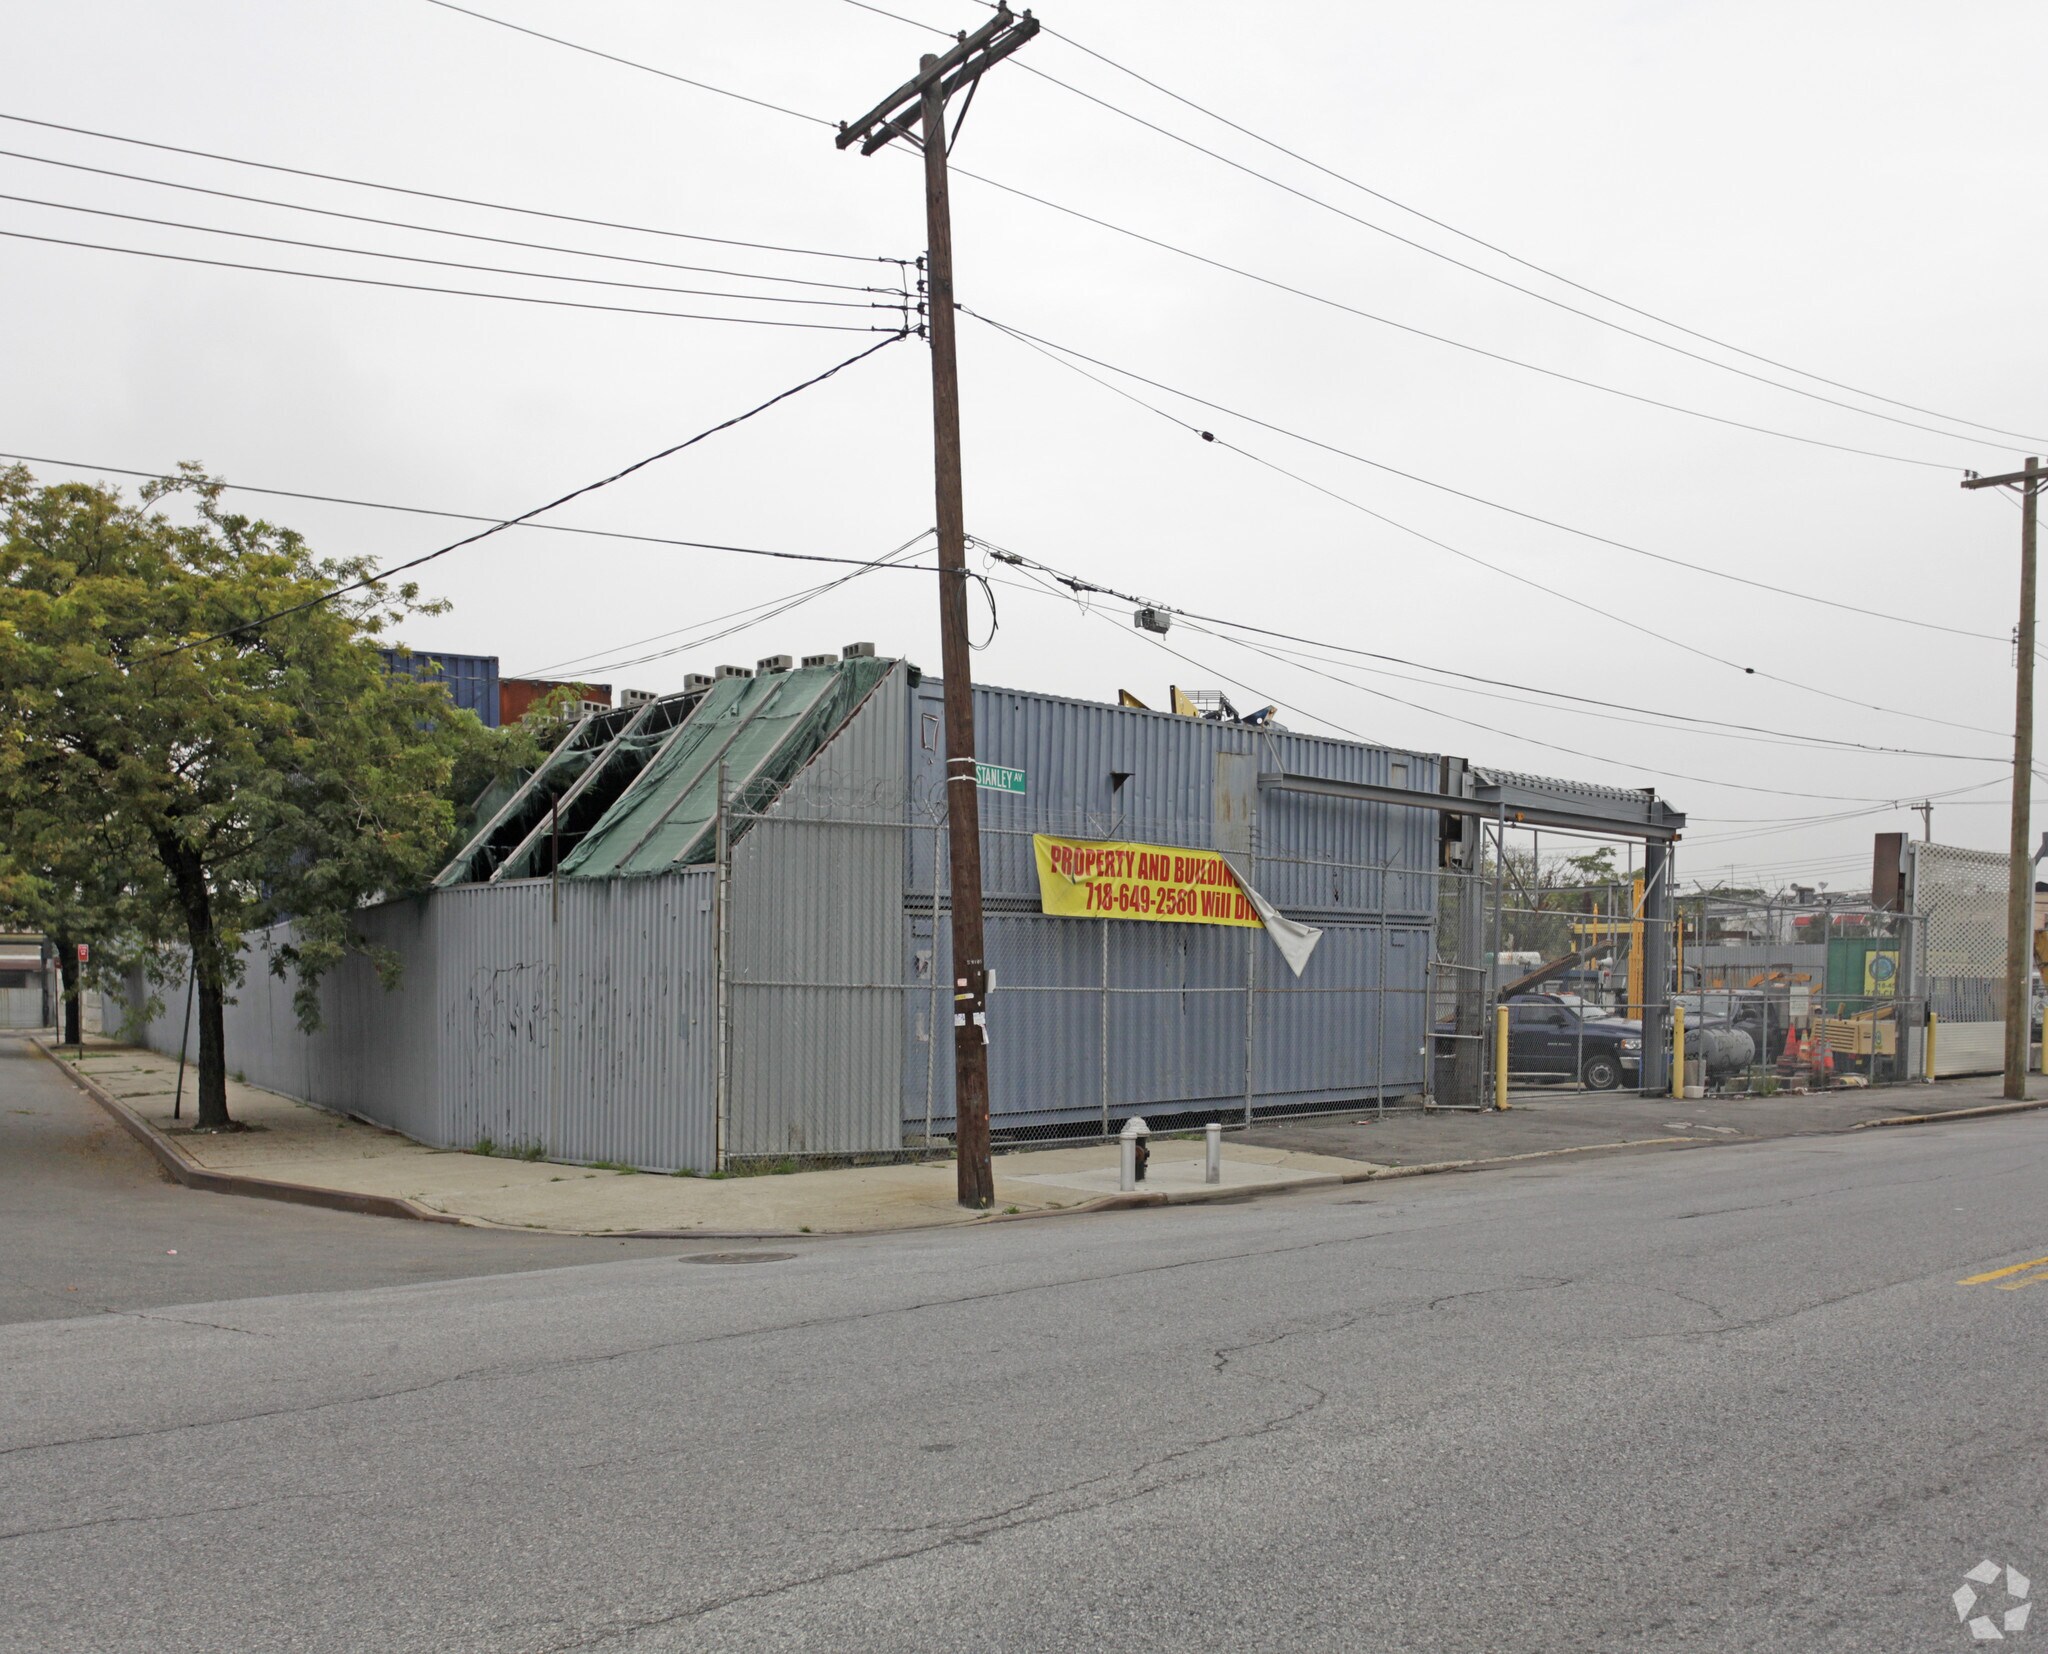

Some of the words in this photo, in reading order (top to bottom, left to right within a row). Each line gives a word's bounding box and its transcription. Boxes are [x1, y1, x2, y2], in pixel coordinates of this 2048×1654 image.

[975, 765, 1013, 789] STANLEY
[1013, 773, 1023, 782] AV
[1050, 845, 1135, 878] PROPERTY
[1138, 852, 1170, 882] AND
[1085, 881, 1197, 916] 718-649-2560
[1201, 890, 1231, 918] Will
